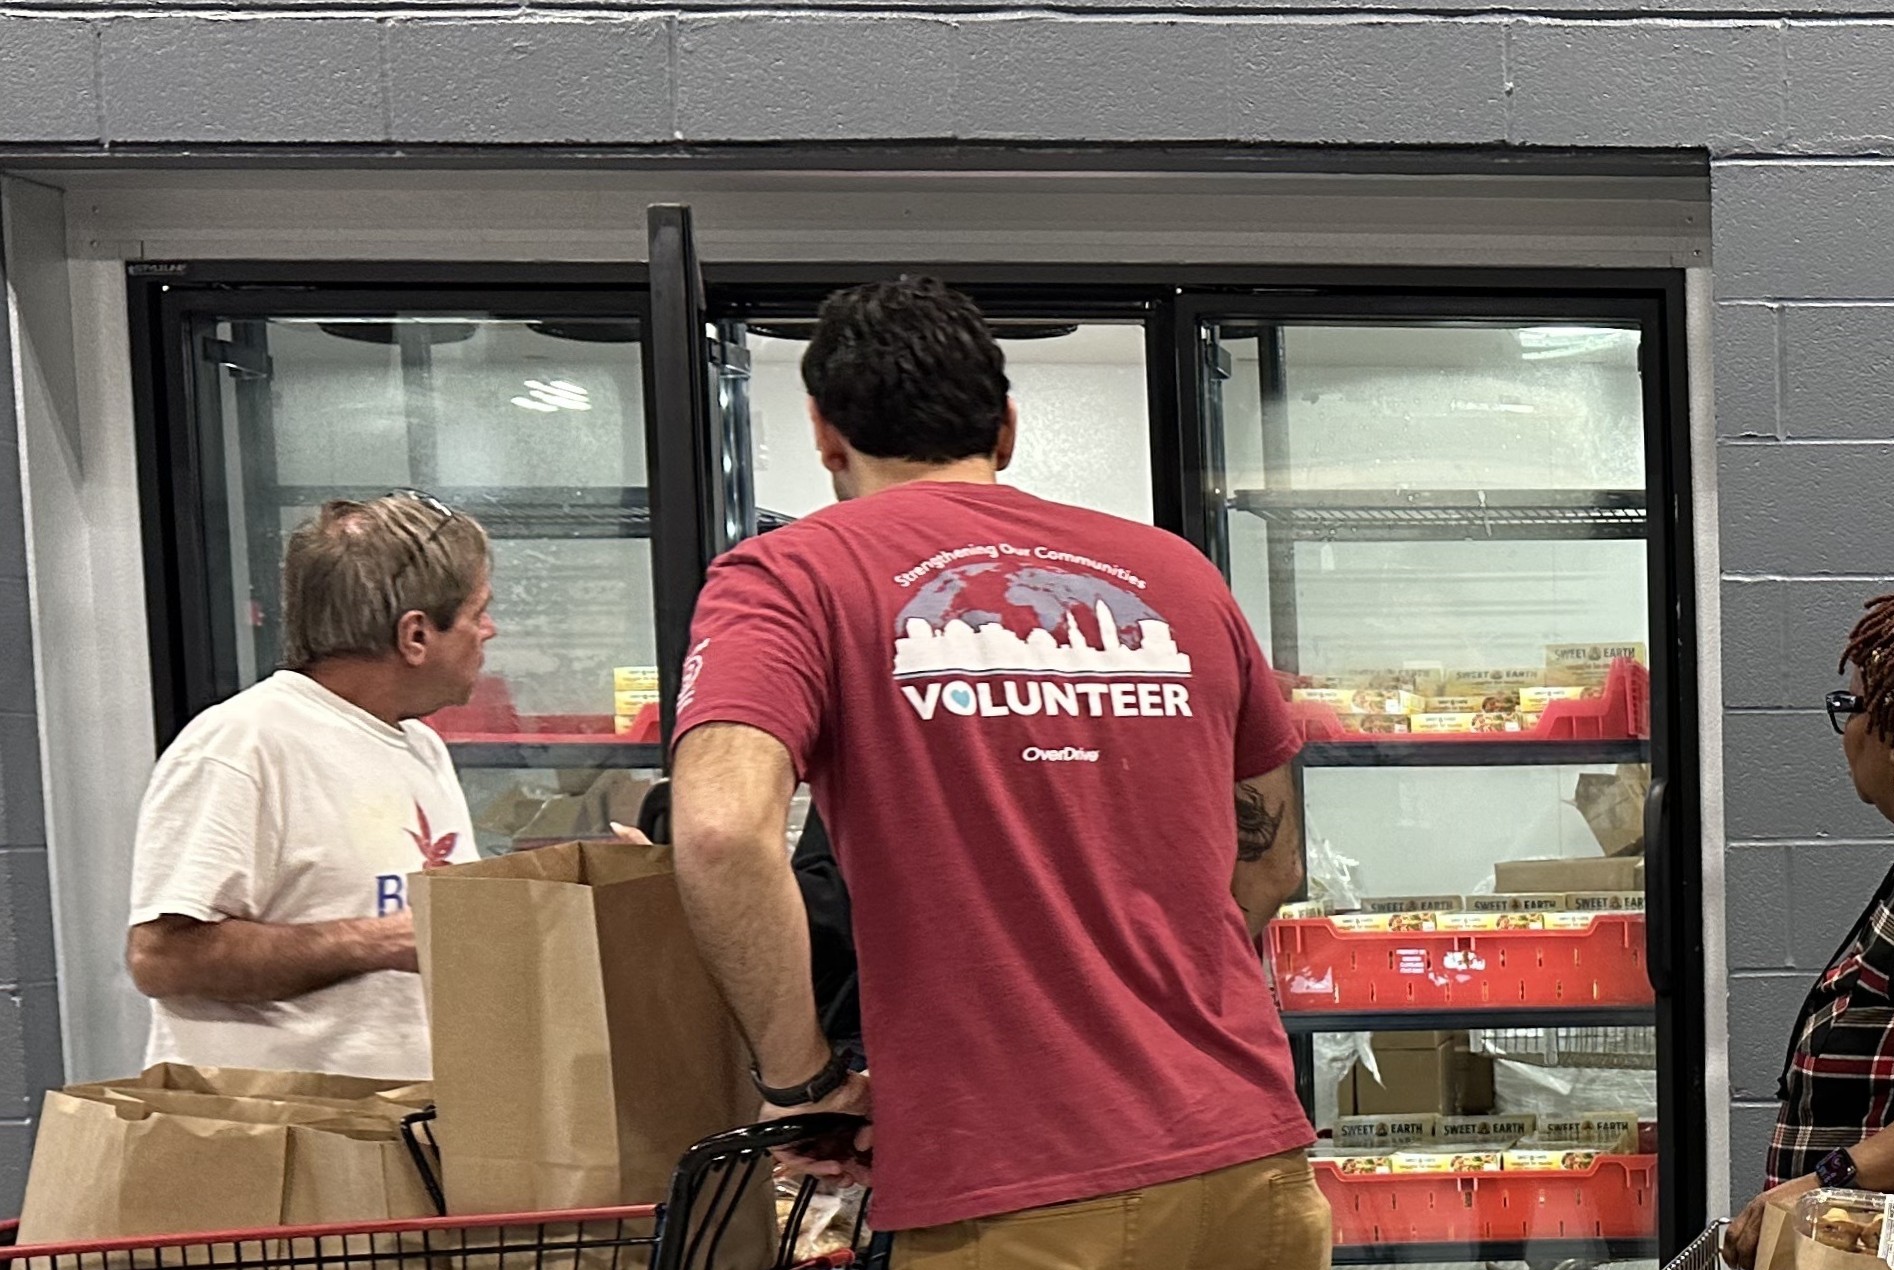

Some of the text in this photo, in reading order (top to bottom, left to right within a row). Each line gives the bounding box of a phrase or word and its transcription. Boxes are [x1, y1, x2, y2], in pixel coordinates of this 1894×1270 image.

[894, 543, 1146, 589] Strengthening Our Communities
[1554, 647, 1635, 660] SWEET EARTH
[1456, 669, 1538, 680] SWEET EARTH
[902, 680, 1193, 720] VOLUNTEER
[1022, 747, 1099, 762] OverDrive
[1370, 901, 1453, 912] SWEET EARTH
[1474, 899, 1556, 911] SWEET EARTH
[1576, 897, 1608, 910] SWEET
[1342, 1123, 1423, 1136] SWEET EARTH
[1444, 1122, 1525, 1136] SWEET EARTH
